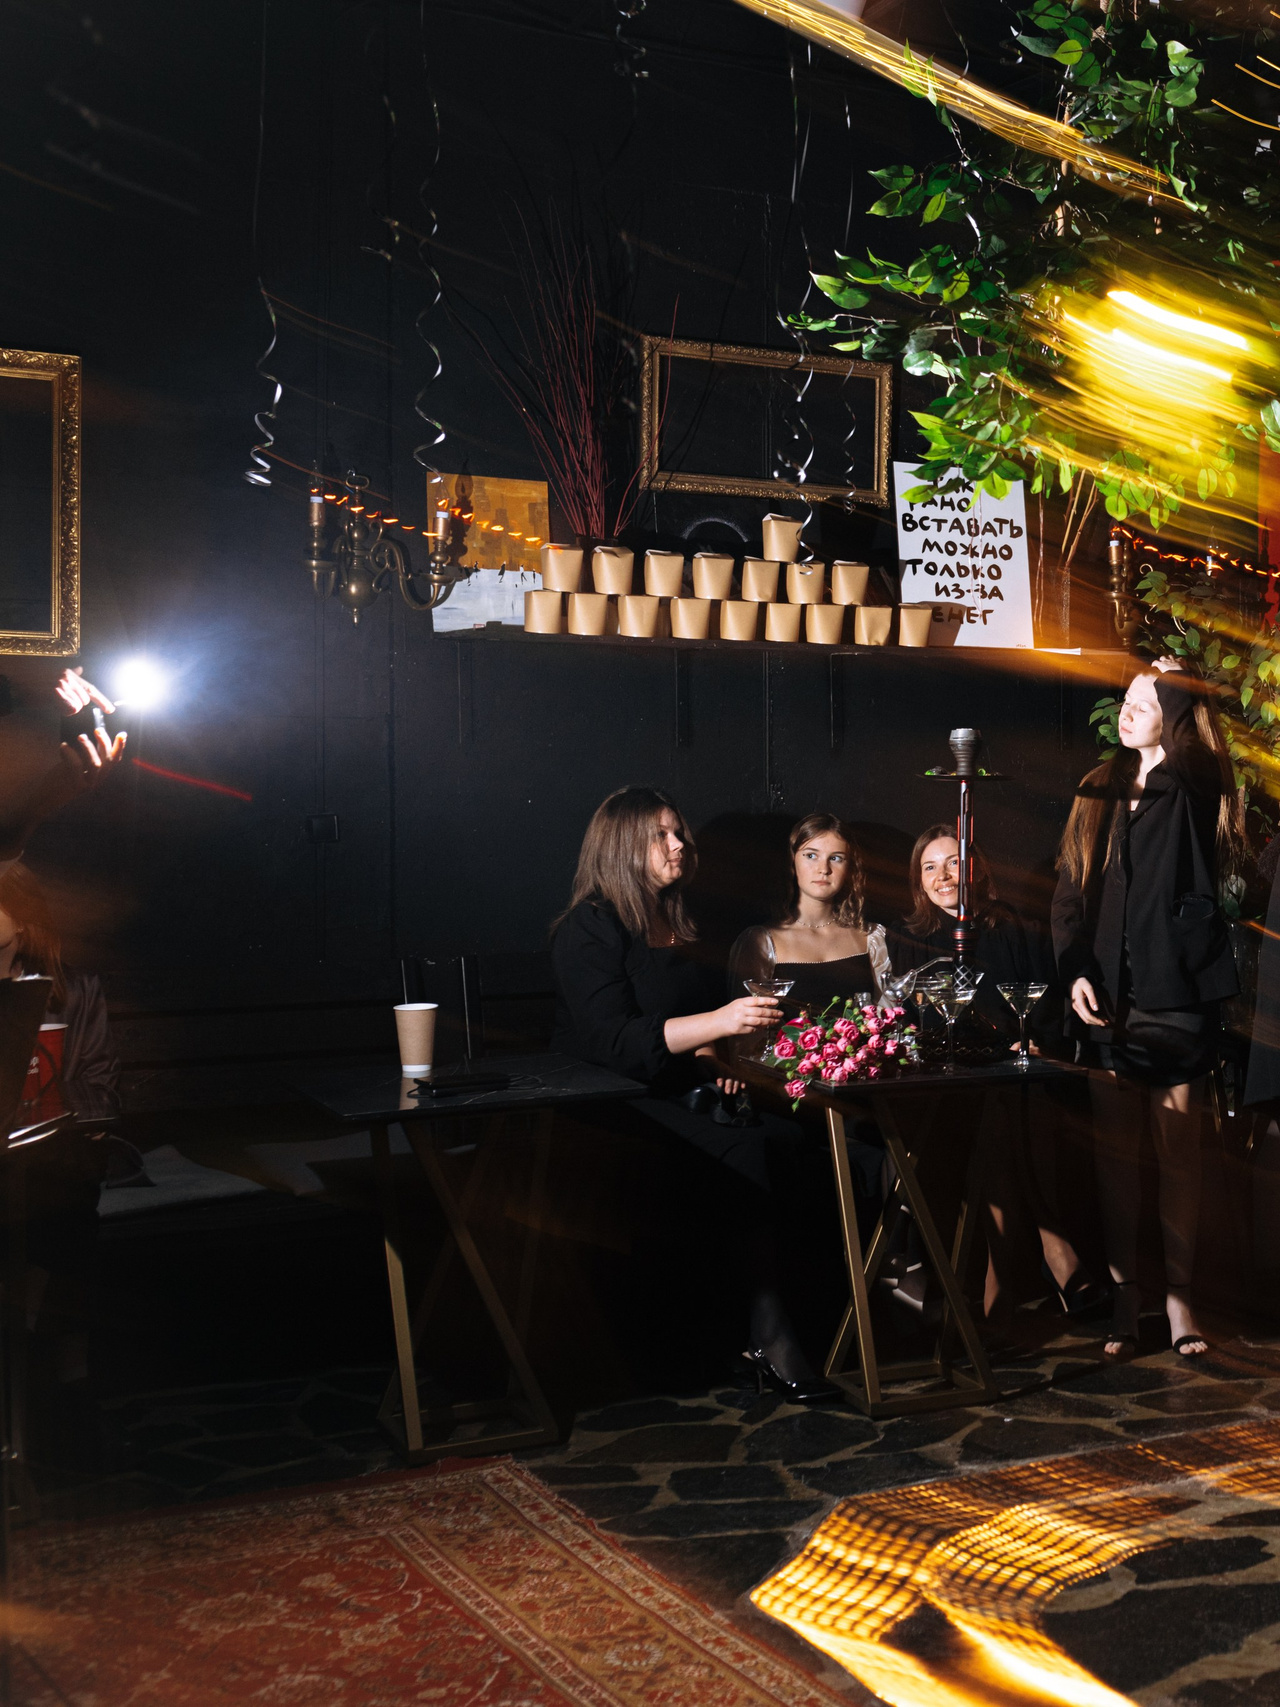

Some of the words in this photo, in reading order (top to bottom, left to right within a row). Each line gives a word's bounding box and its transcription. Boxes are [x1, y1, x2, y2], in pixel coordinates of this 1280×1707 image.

[902, 512, 1023, 539] ВСТАВАТЬ
[922, 538, 1013, 560] МОЖНО
[906, 558, 1002, 581] ТОЛЬКО
[935, 582, 1004, 601] ИЗ-ЗА
[932, 606, 994, 626] ЕНЕГ
